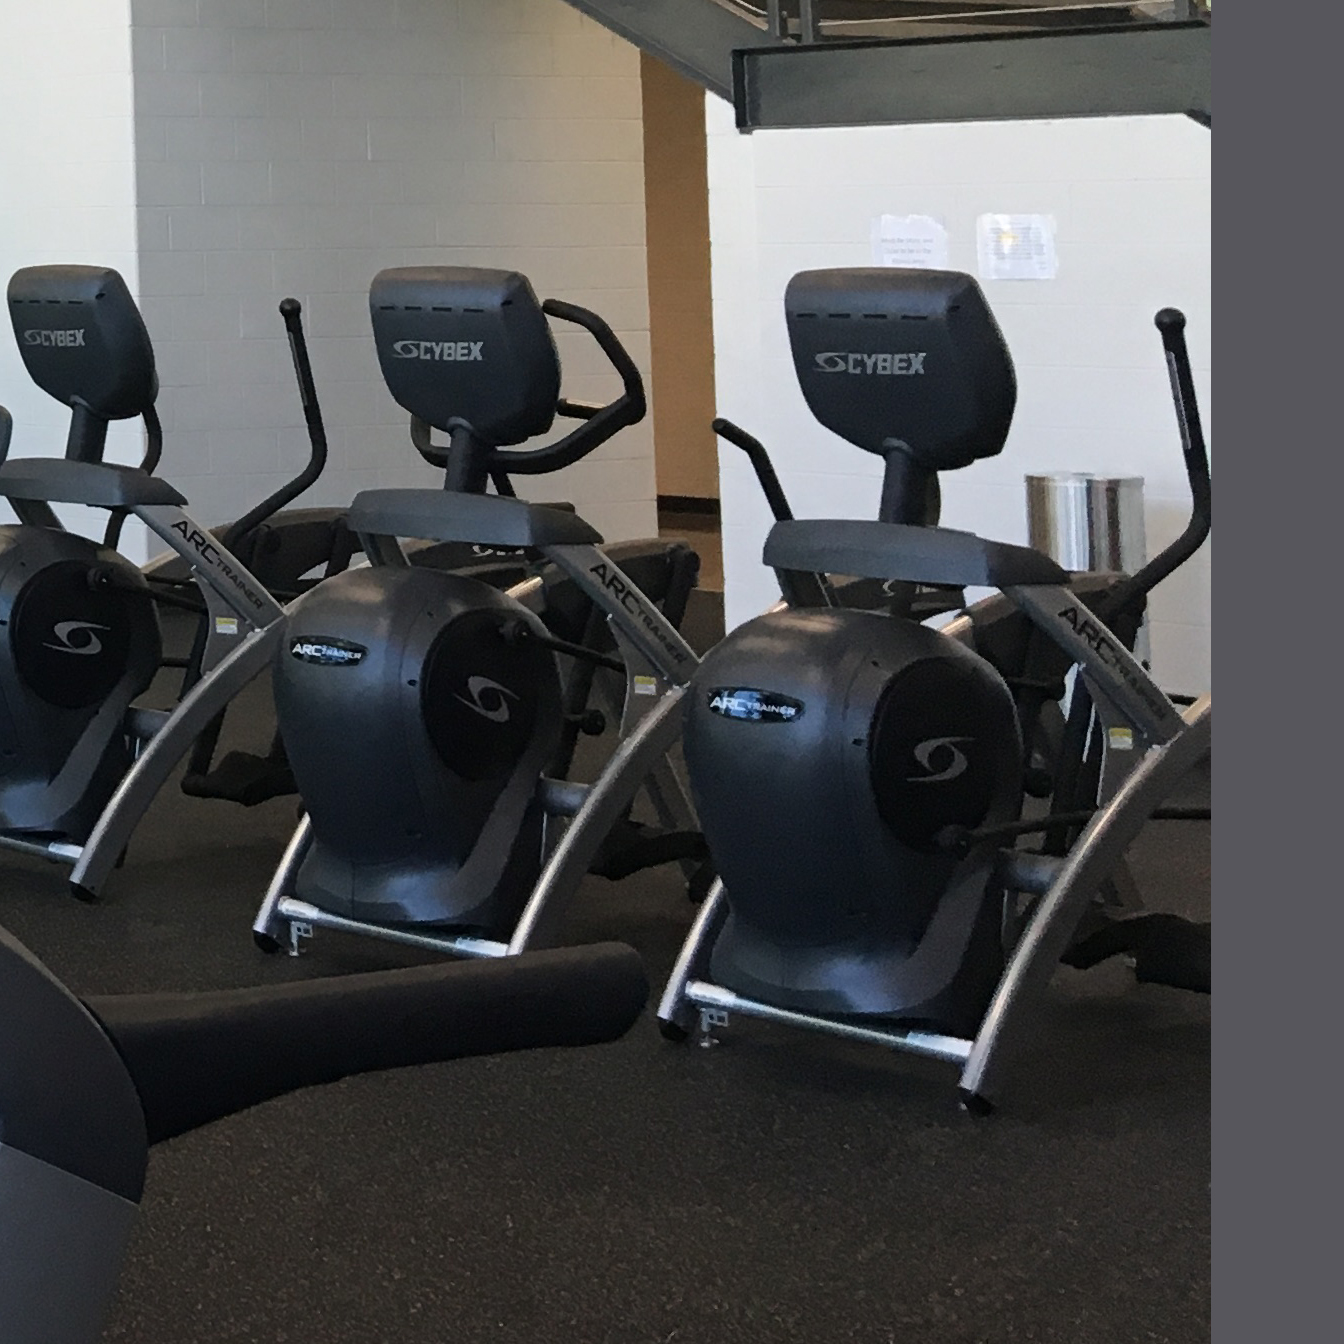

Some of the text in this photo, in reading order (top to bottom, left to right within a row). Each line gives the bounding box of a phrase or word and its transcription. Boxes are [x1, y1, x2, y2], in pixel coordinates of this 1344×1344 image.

[40, 328, 86, 347] CYBEX
[419, 341, 484, 361] CYBEX
[848, 352, 927, 375] CYBEX
[170, 520, 264, 610] ARC TRAINER
[589, 563, 640, 615] ARC
[1057, 606, 1116, 665] ARC
[292, 642, 322, 657] ARC
[710, 696, 746, 713] ARC
